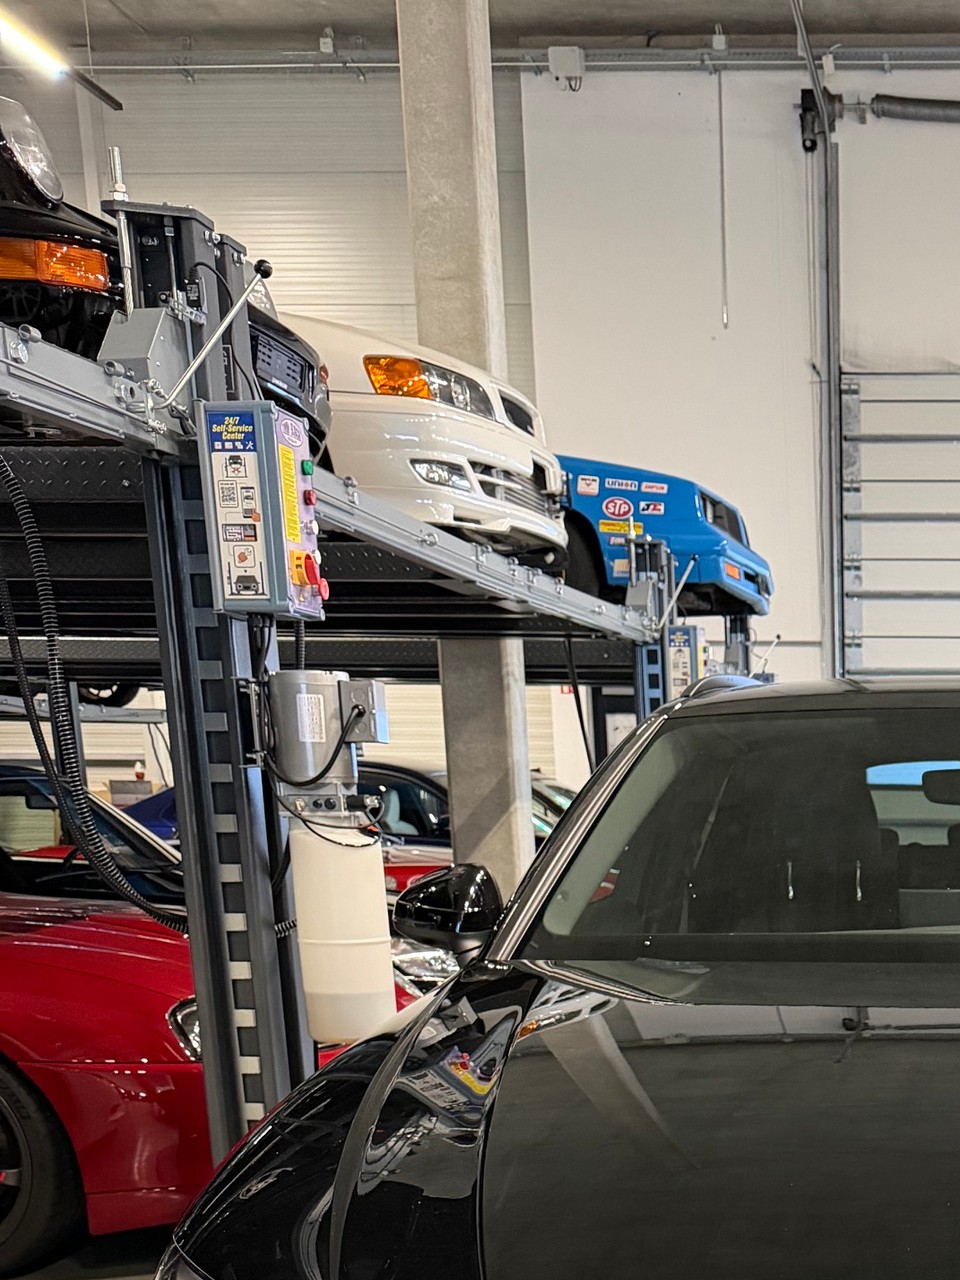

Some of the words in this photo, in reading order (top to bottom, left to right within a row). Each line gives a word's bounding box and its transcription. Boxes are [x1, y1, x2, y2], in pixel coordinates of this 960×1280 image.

[224, 416, 240, 425] 24/7
[212, 424, 253, 433] Self-Service
[222, 432, 245, 440] Center
[607, 500, 630, 514] STP
